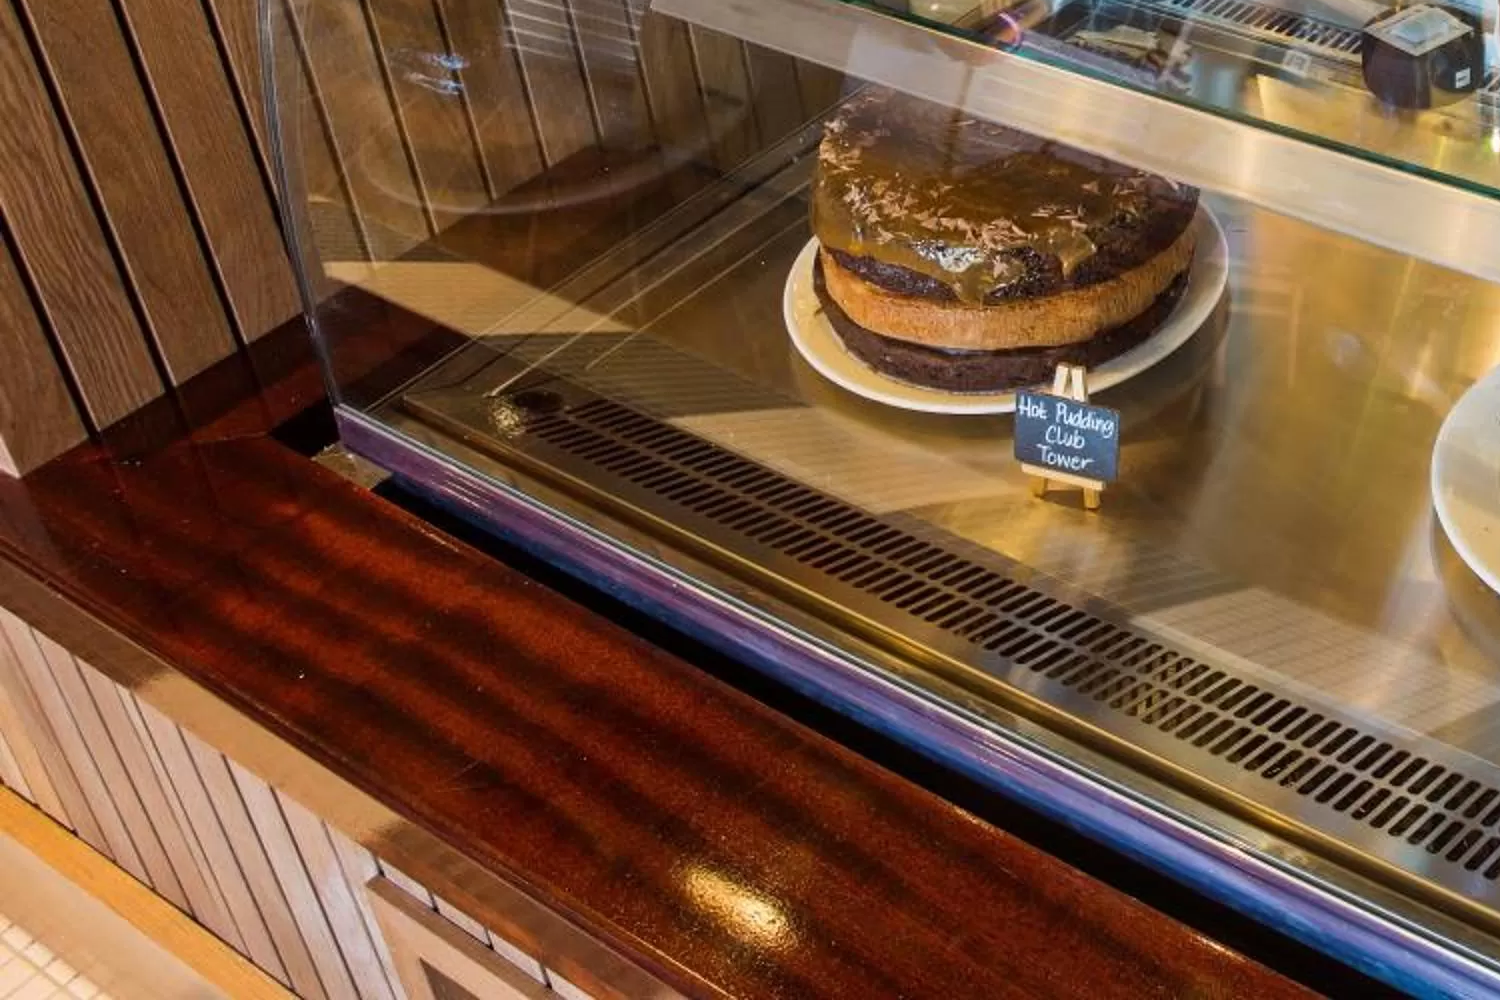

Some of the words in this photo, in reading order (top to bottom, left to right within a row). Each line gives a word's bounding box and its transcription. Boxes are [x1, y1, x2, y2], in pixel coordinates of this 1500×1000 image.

[1018, 395, 1048, 420] Hot
[1055, 402, 1115, 439] Pudding
[1045, 425, 1085, 449] Club
[1036, 443, 1095, 471] Tower
